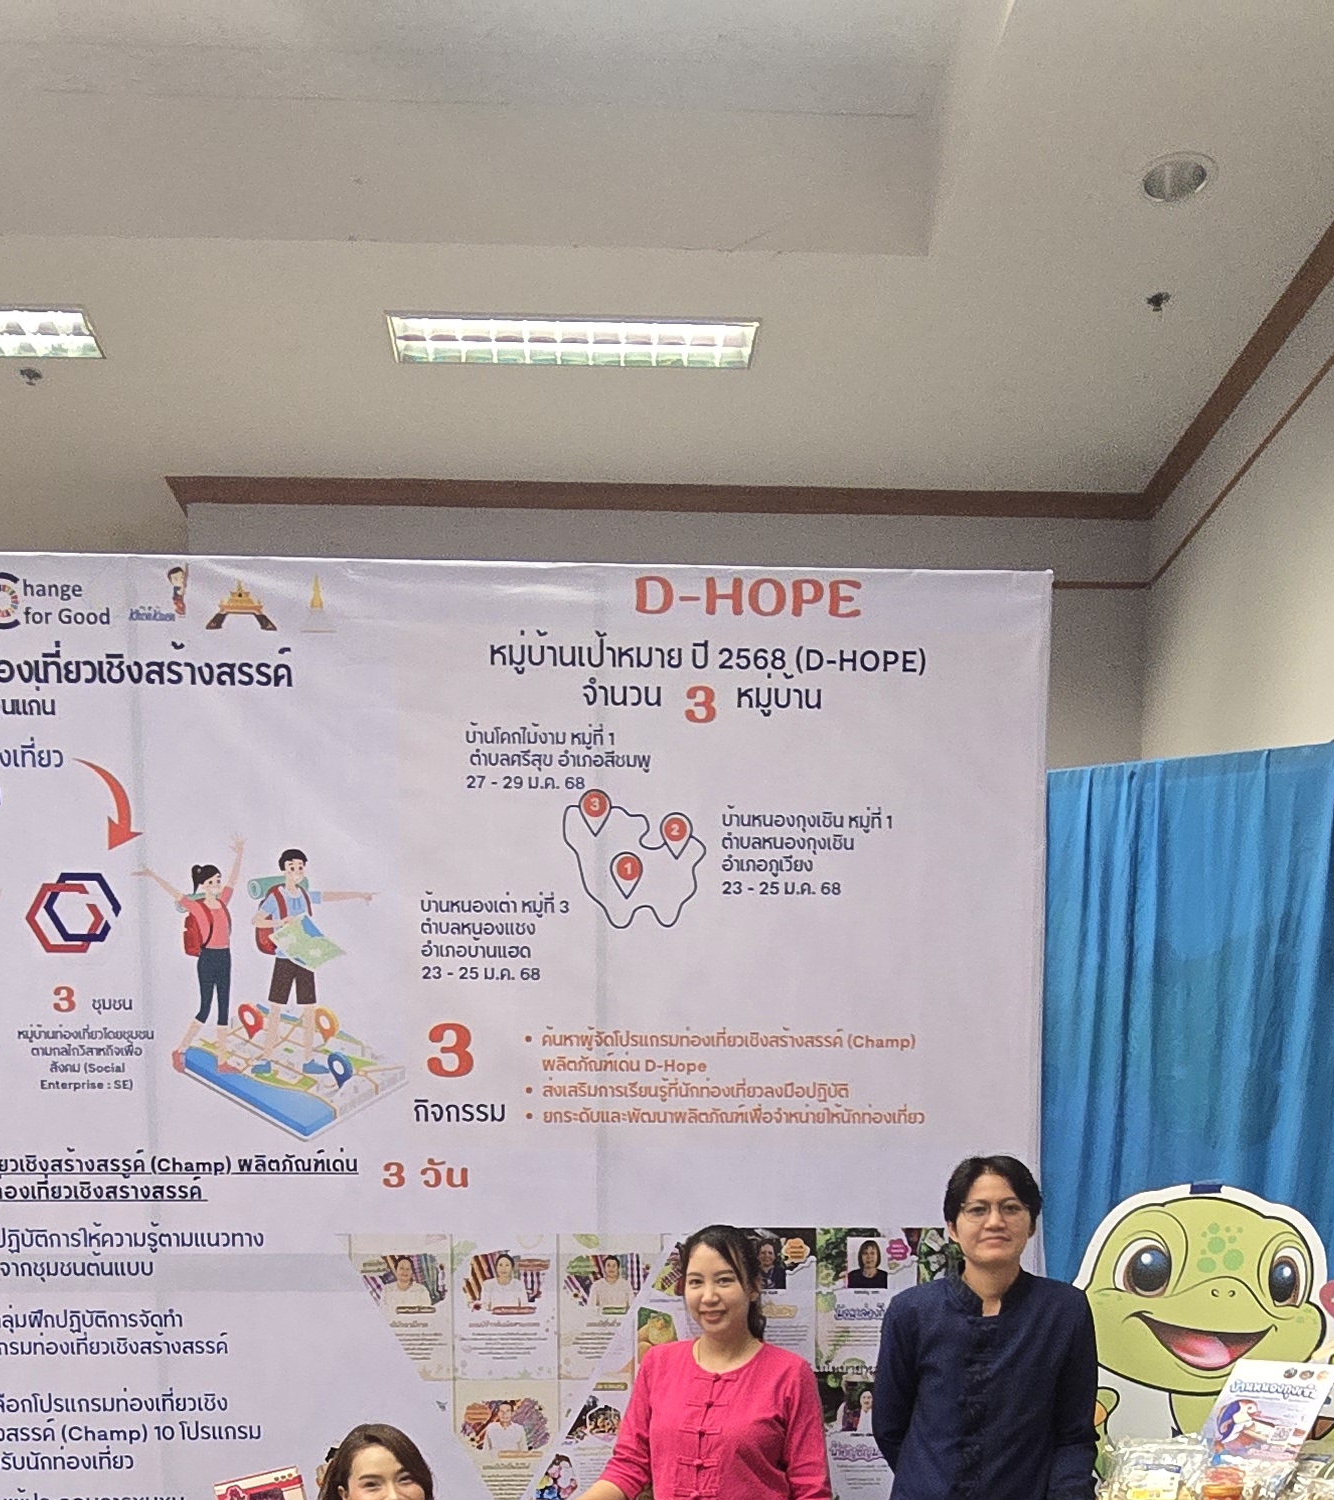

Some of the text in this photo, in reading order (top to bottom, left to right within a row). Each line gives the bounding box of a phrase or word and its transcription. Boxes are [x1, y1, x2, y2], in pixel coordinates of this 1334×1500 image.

[634, 575, 863, 618] D-HOPE
[24, 606, 52, 627] for
[58, 606, 110, 627] Good
[489, 629, 926, 676] หมู่บ้านเป้าหมาย ปี 2568 (D-HOPE)
[582, 673, 823, 724] จำนวน 3 หมู่บ้าน
[465, 721, 567, 746] บ้านโคกไม้งาม
[570, 723, 604, 750] หมู่ที่
[469, 747, 652, 774] ตำบลศรีสุข อำเภอสีชมพู
[466, 775, 586, 791] 27 29 ม.ค. 68
[848, 806, 883, 834] หมู่ที่
[721, 853, 814, 878] อำเภอภูเวียง
[721, 881, 842, 896] 23 25 ม.ค. 68
[420, 890, 570, 918] บ้านหนองเต่า หมู่ที่ 3
[421, 936, 532, 959] อำเภอบ้านแฮด
[421, 965, 541, 981] 23 25 ม.ค. 68
[52, 986, 133, 1014] 3 ชุมชน
[426, 1021, 475, 1079] 3
[847, 1033, 917, 1051] (Champ)
[83, 1062, 126, 1075] (Social
[541, 1050, 708, 1075] ผลิตภัณฑ์เด่น D-Hope
[40, 1079, 104, 1091] Enterprise
[113, 1079, 134, 1091] SE)
[413, 1098, 507, 1124] กิจกรรม
[150, 1156, 232, 1176] (Champ)
[237, 1148, 359, 1174] ผลิตภัณฑ์เด่น
[381, 1161, 406, 1190] 3
[419, 1158, 469, 1189] วัน
[0, 1252, 155, 1282] จากชุมชนต้นแบบ
[61, 1424, 148, 1447] (Champ)
[154, 1425, 175, 1442] 10
[179, 1421, 262, 1442] โปรแกรม
